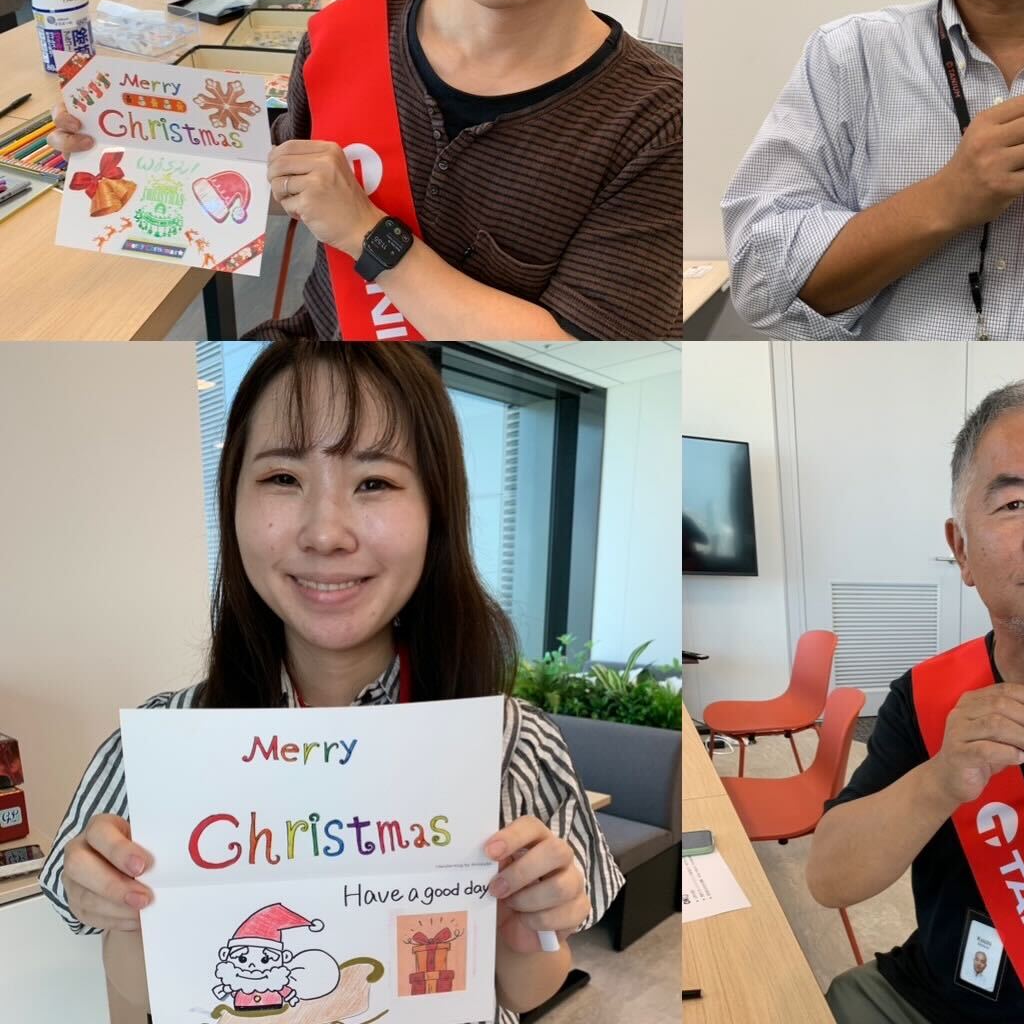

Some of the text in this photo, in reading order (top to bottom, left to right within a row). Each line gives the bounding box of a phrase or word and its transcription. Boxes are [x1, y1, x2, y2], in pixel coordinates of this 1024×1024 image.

[119, 73, 181, 96] Merry
[98, 109, 243, 149] Christmas
[241, 735, 358, 765] Merry
[188, 811, 451, 870] Christmas
[344, 880, 490, 907] Have a good day
